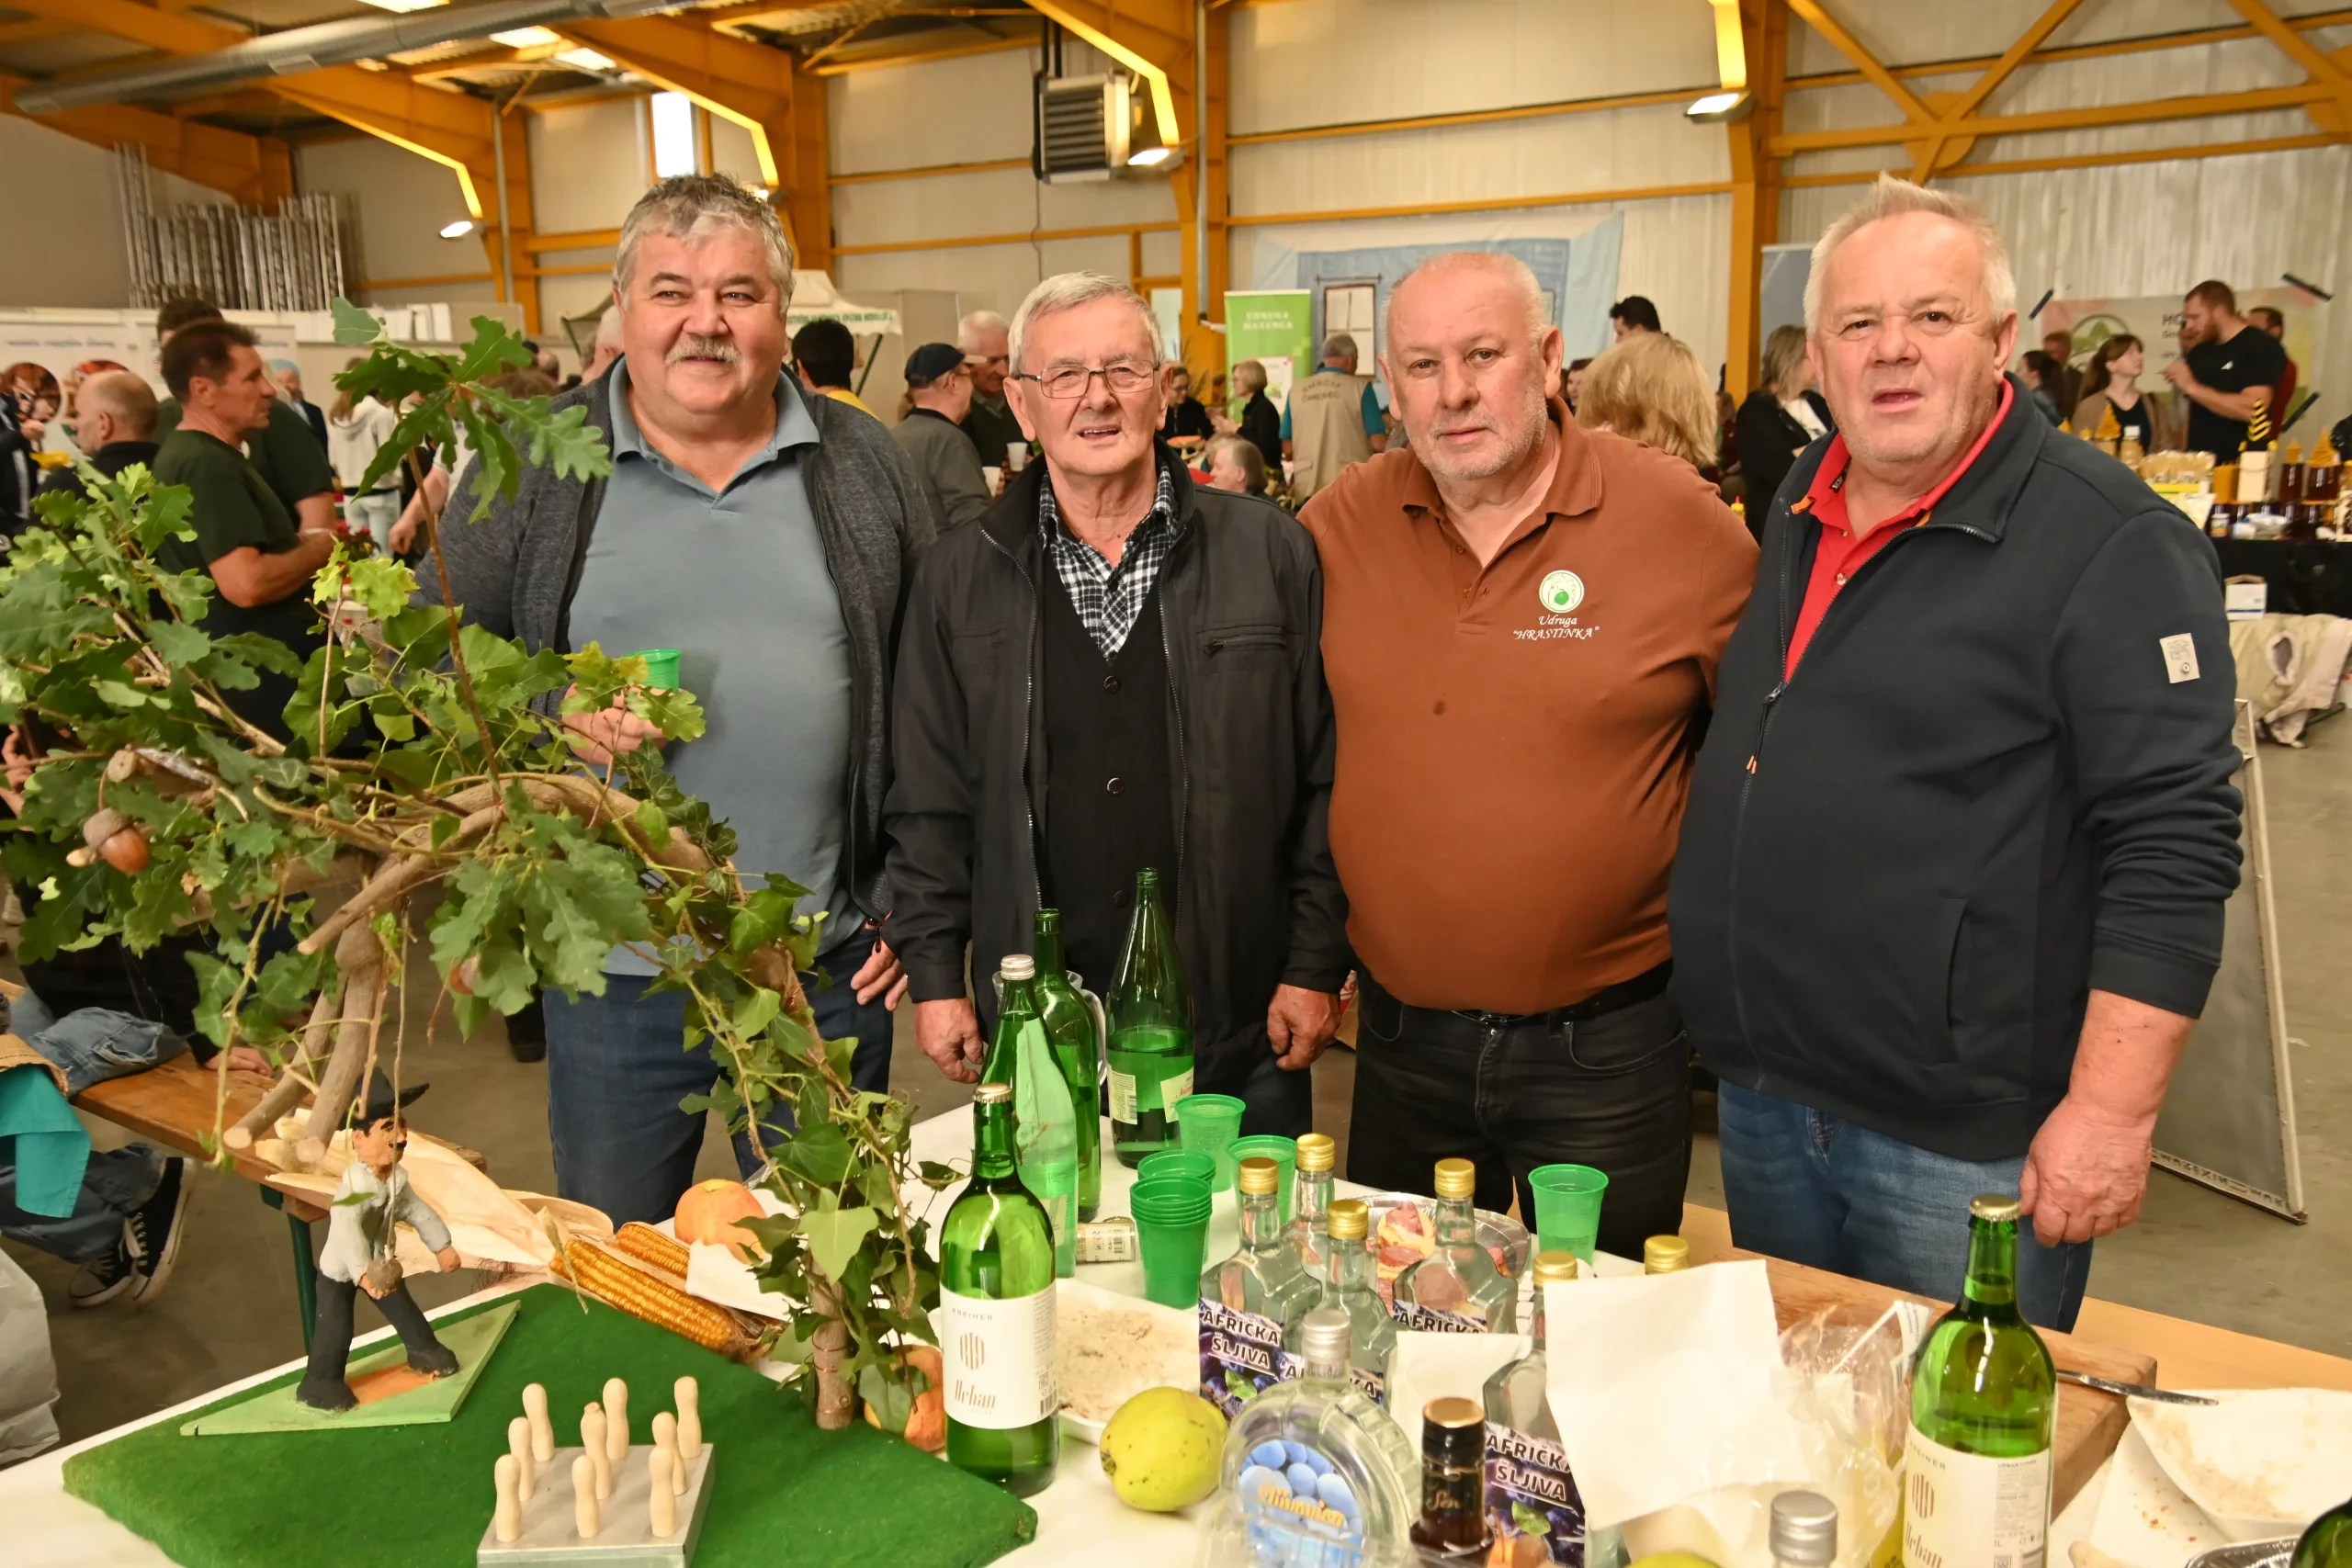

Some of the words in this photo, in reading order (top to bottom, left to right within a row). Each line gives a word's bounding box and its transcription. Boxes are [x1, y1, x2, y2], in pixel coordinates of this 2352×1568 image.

[1538, 615, 1577, 628] Udruga
[952, 1308, 993, 1321] PREINER
[1203, 1310, 1279, 1346] AFRIČKA
[1212, 1333, 1270, 1368] ŠLJIVA
[955, 1379, 996, 1409] Urban
[1496, 1460, 1566, 1501] ŠLJIVA
